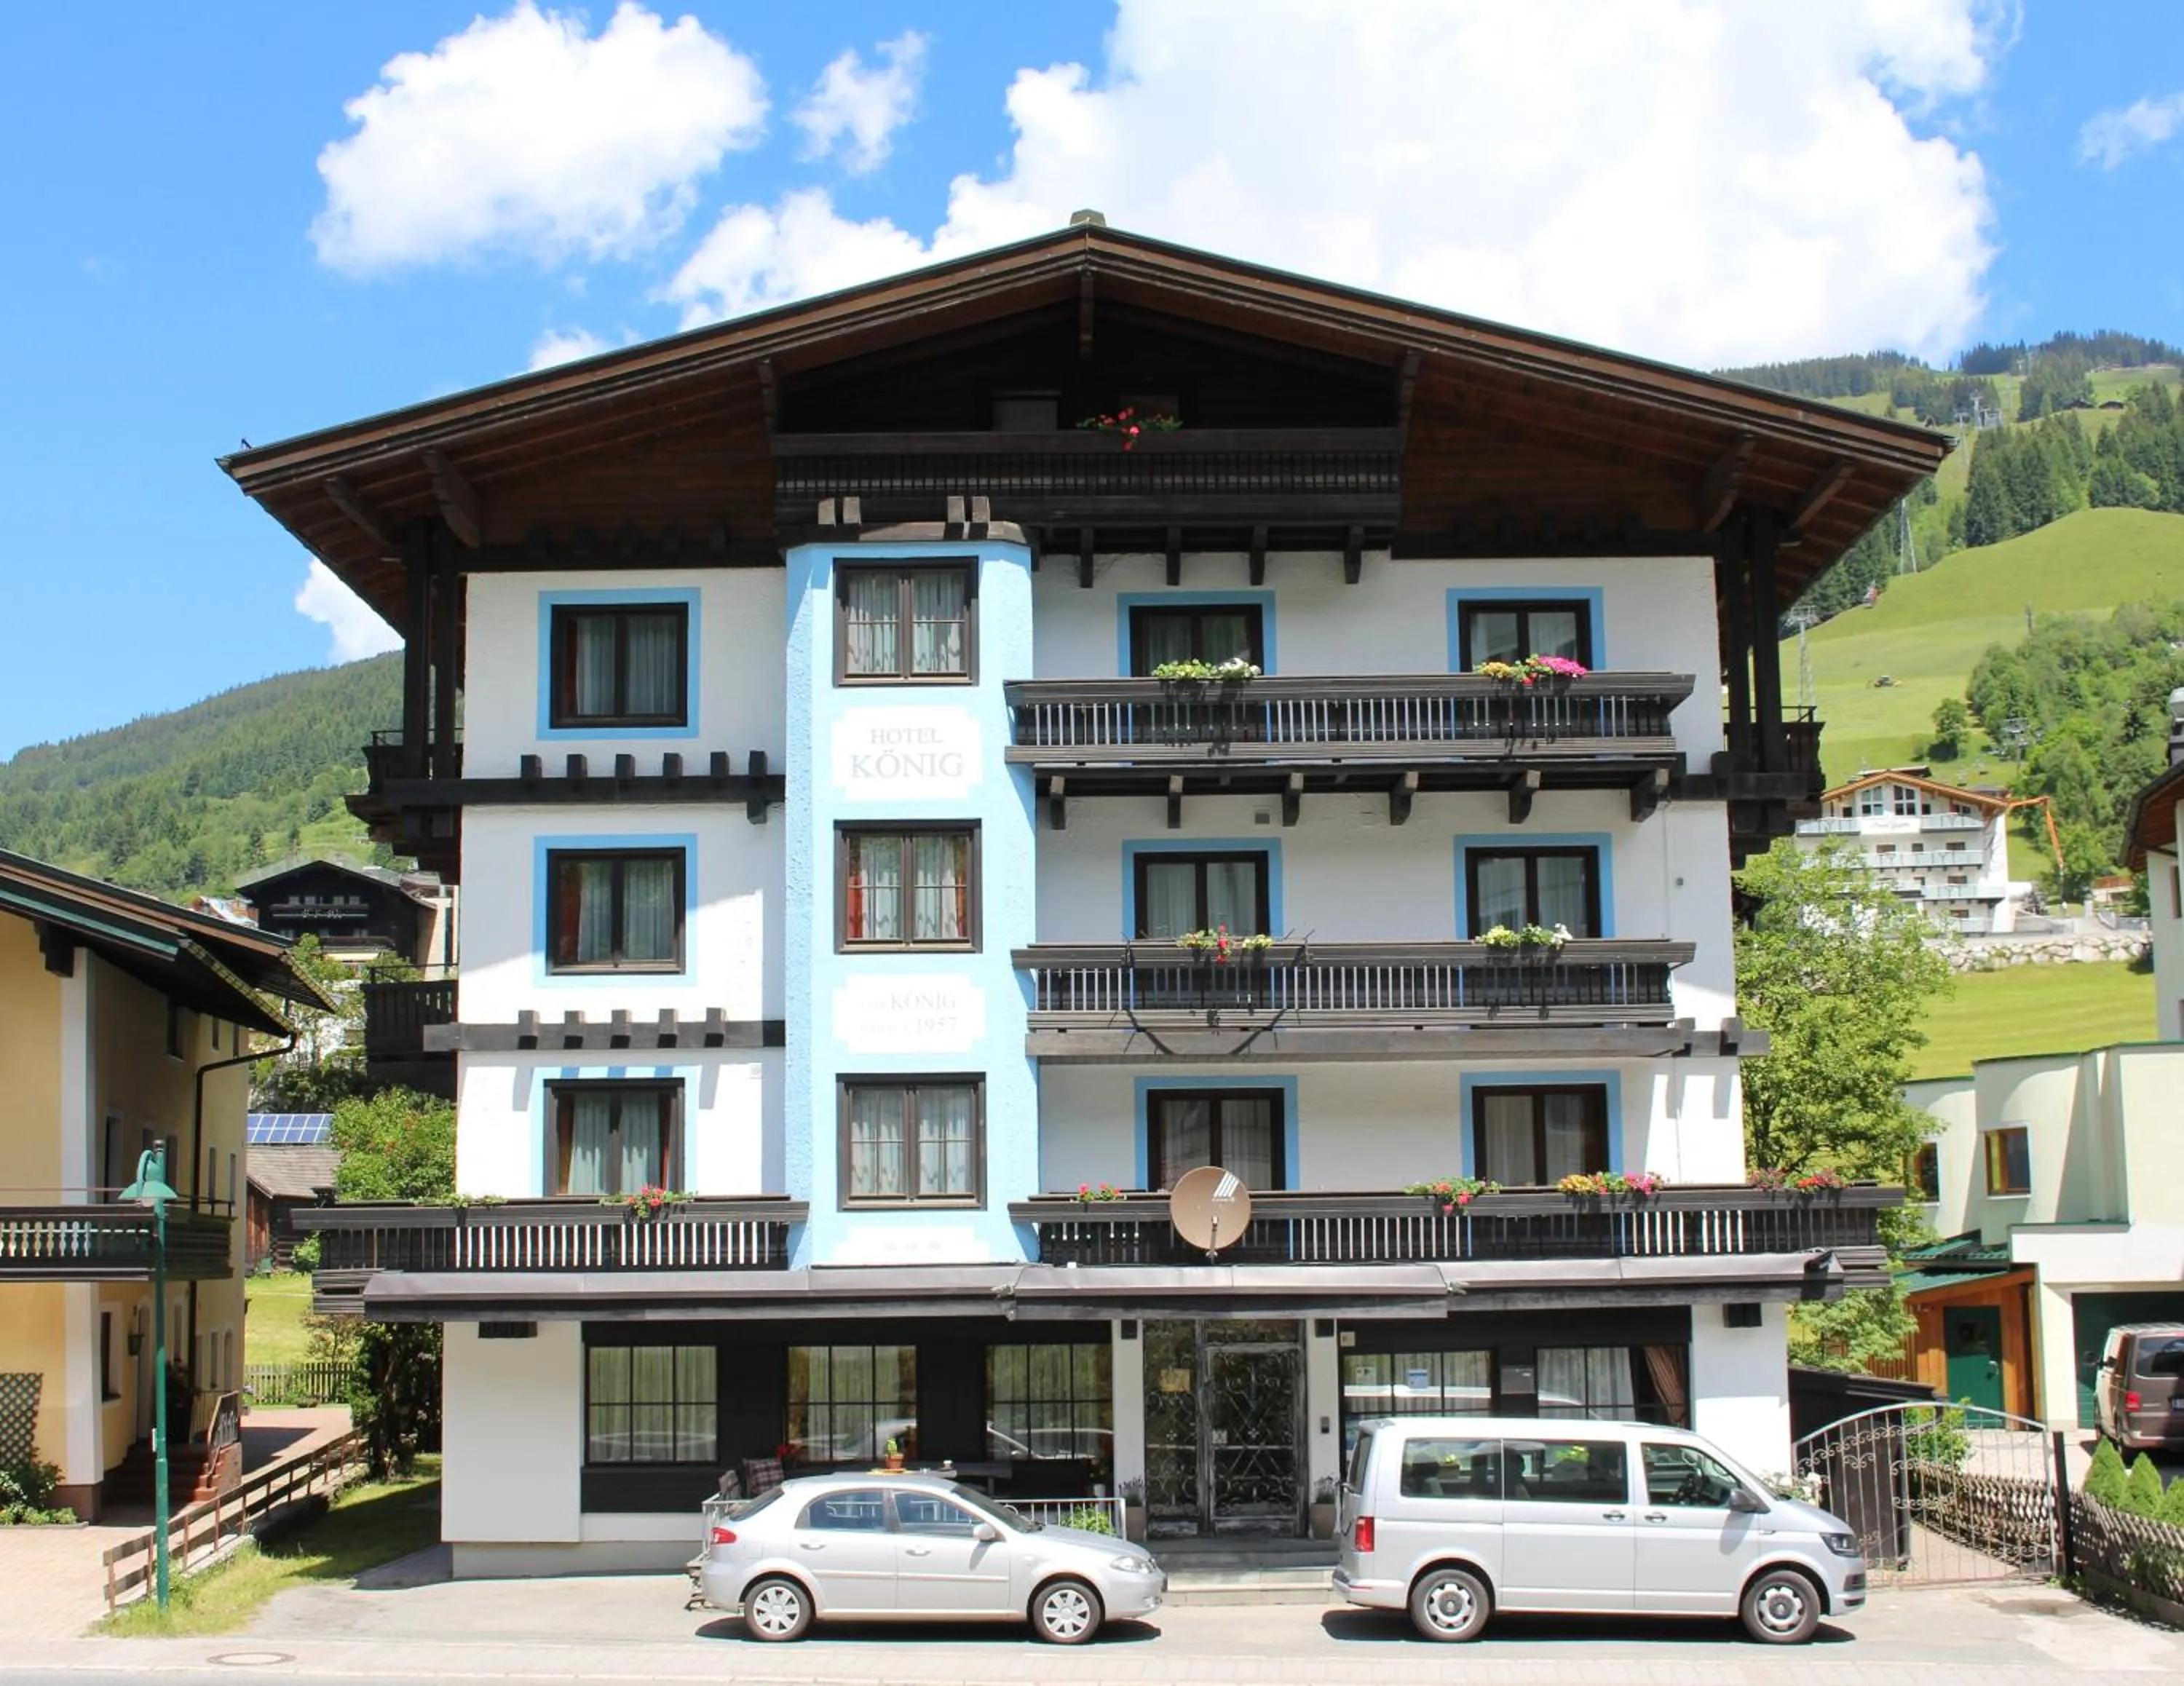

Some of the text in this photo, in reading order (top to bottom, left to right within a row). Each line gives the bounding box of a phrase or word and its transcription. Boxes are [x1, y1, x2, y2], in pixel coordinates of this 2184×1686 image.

[870, 727, 944, 744] HOTEL
[850, 749, 963, 778] KÖNIG
[917, 1016, 957, 1034] 1957
